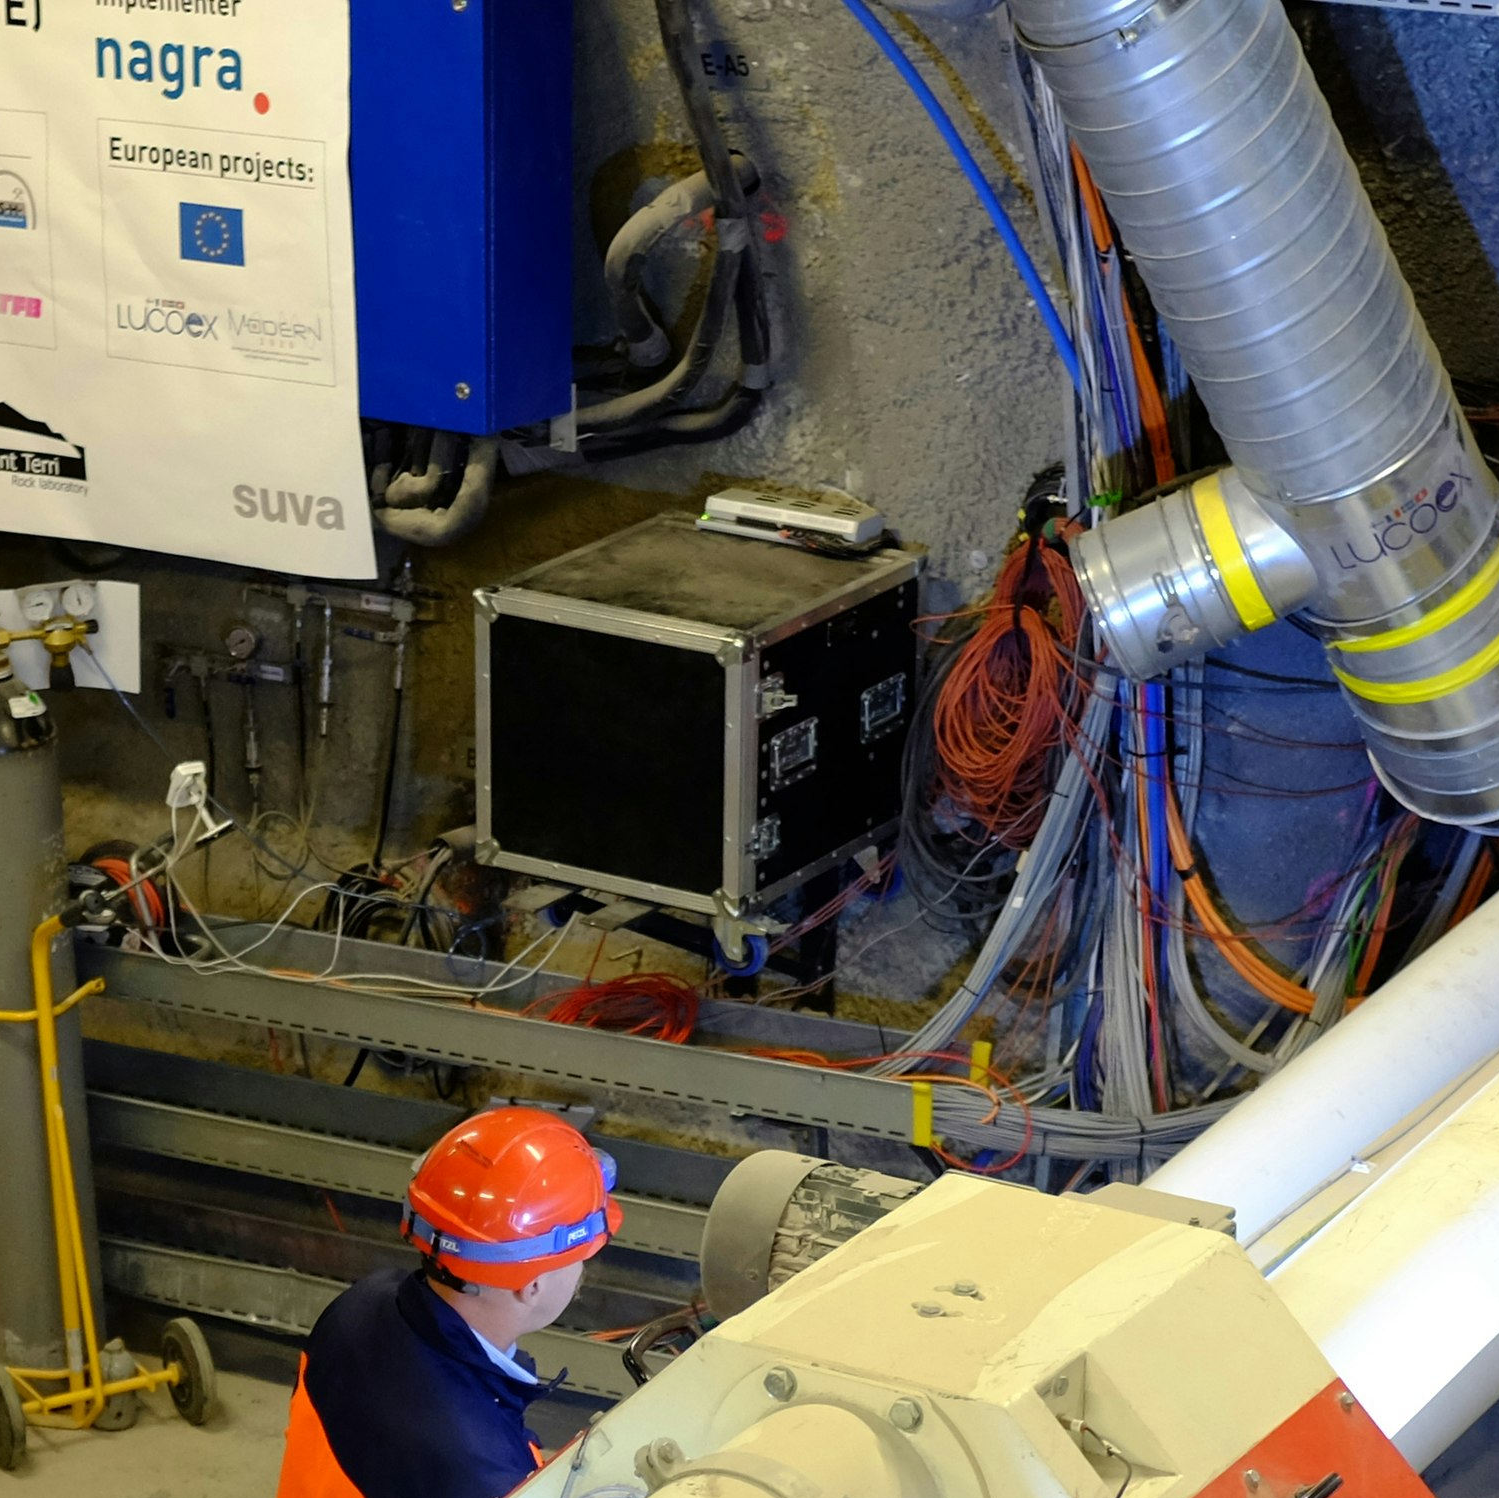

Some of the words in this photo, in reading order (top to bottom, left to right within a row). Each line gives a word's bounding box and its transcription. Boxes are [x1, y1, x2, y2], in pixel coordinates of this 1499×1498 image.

[109, 137, 212, 172] European
[219, 155, 314, 182] projects:
[21, 452, 60, 476] Terri
[12, 475, 36, 489] Rock
[233, 484, 345, 531] suva
